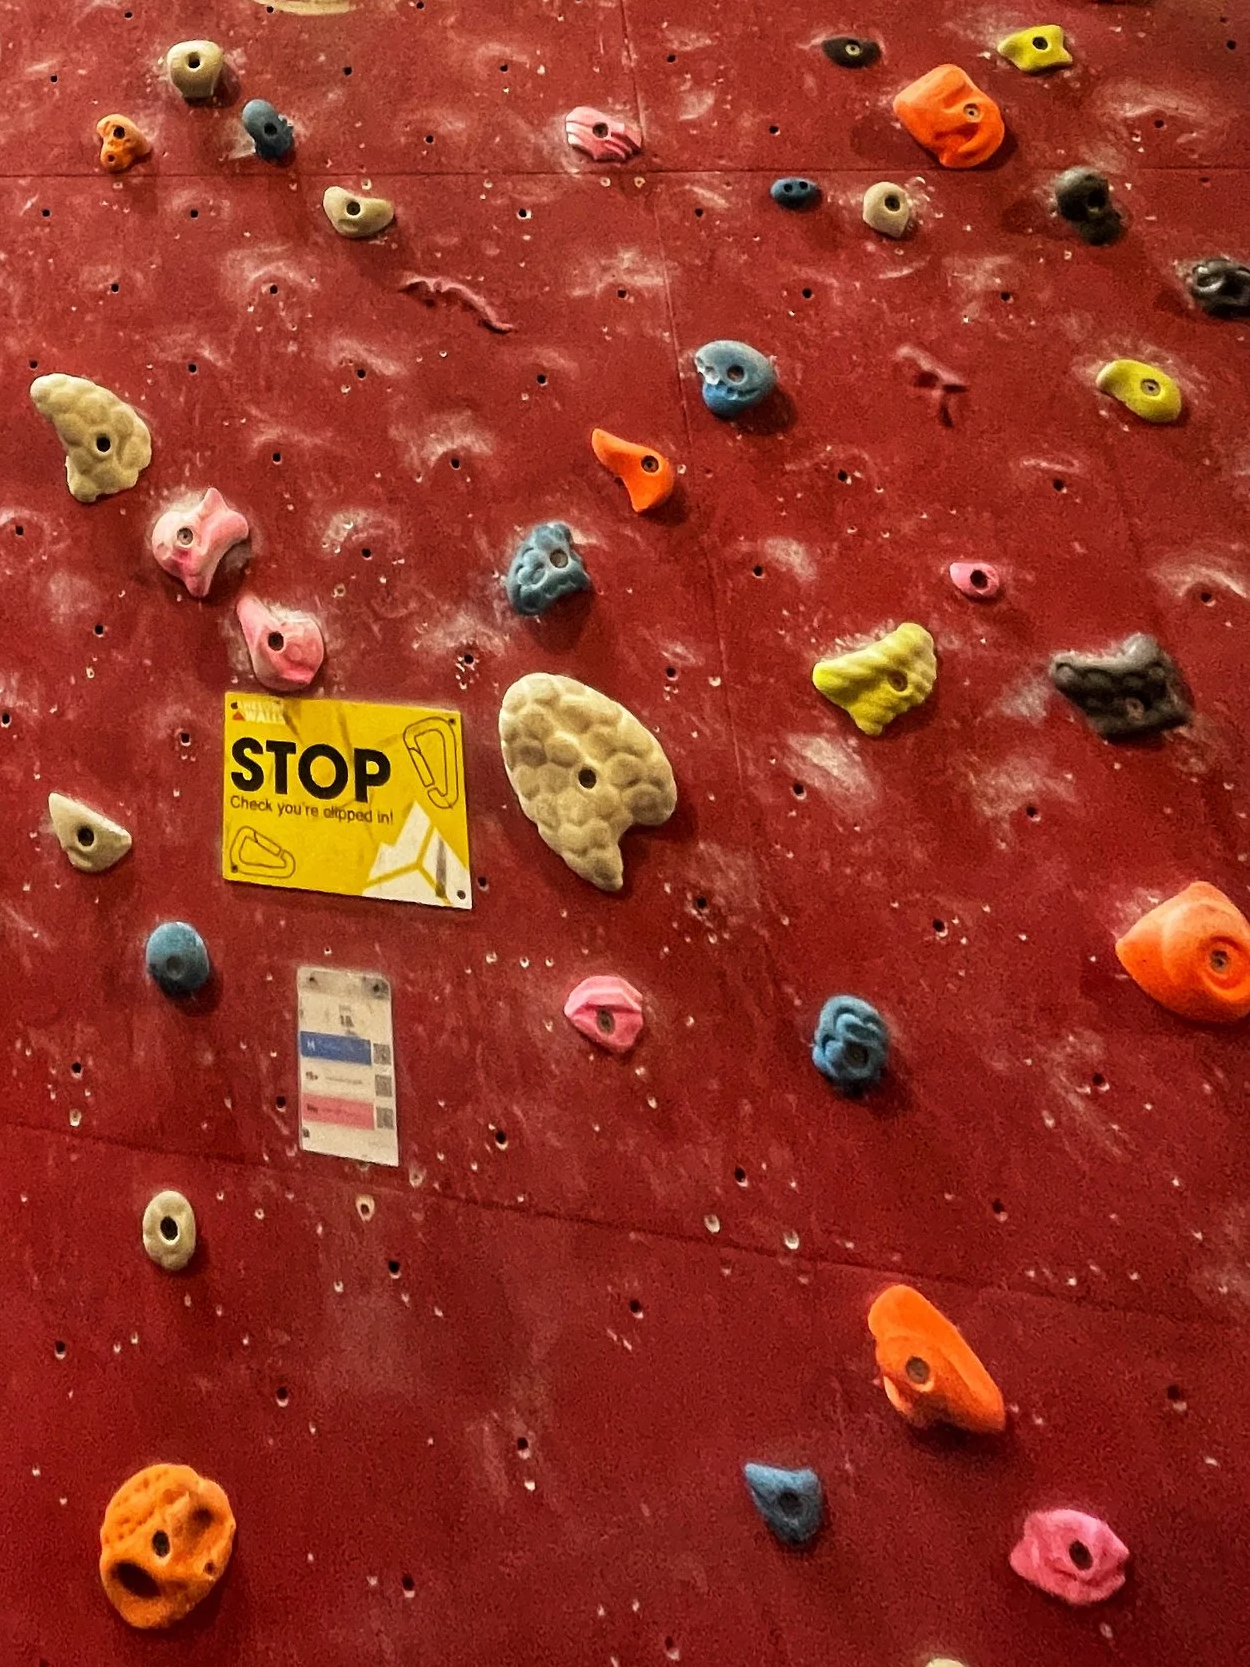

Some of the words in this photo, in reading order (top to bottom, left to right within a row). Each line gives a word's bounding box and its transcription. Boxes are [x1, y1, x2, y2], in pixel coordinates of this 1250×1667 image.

[230, 737, 391, 804] STOP
[230, 795, 272, 812] Check
[277, 800, 319, 821] you're
[323, 804, 373, 824] clipped
[377, 811, 394, 825] in!
